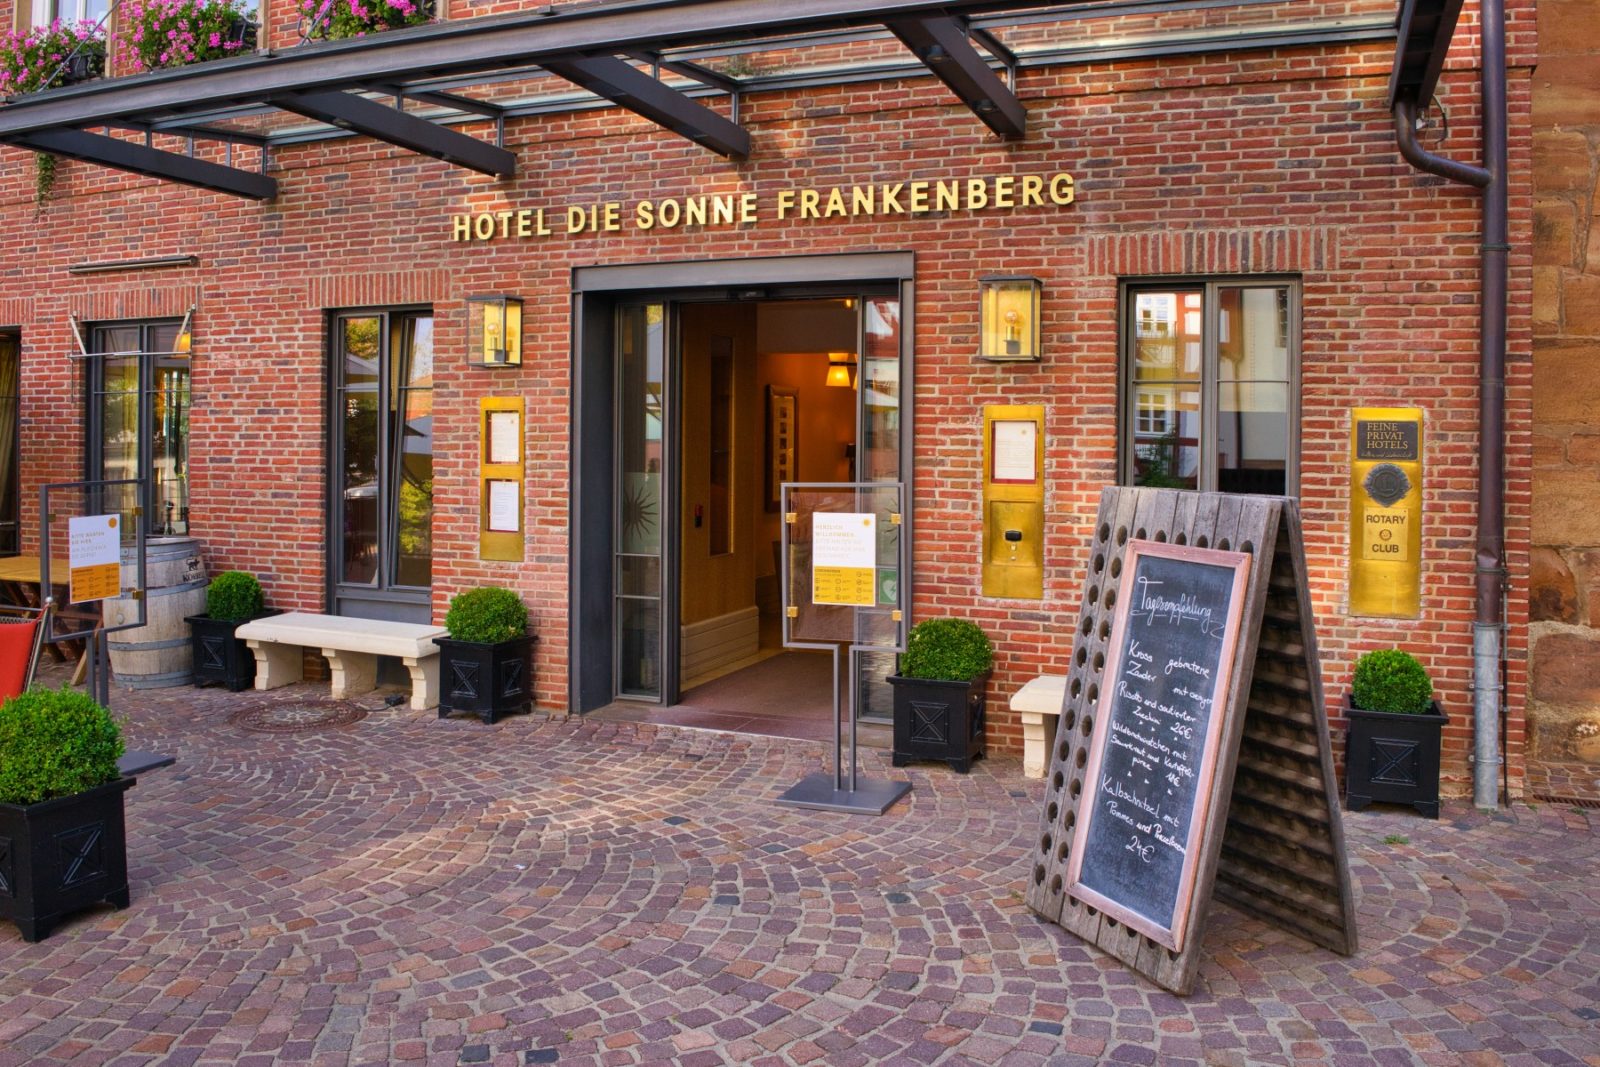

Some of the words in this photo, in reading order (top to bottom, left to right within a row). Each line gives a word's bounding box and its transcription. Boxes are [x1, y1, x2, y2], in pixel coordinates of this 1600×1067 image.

[453, 208, 551, 242] HOTEL
[567, 203, 620, 234] DIE
[636, 193, 758, 230] SONNE
[777, 172, 1076, 220] FRANKENBERG
[1367, 422, 1398, 431] FEINE
[1367, 431, 1404, 440] PRIVAT
[1366, 440, 1409, 449] HOTELS
[1366, 514, 1406, 524] ROTARY
[1371, 543, 1399, 553] CLUB
[1172, 686, 1189, 696] mit
[1144, 699, 1158, 709] und
[1170, 722, 1193, 740] 26€
[1172, 751, 1188, 761] mit
[1106, 800, 1134, 826] Pommes
[1136, 822, 1152, 834] und
[1163, 814, 1180, 827] mit
[1125, 835, 1155, 863] 24€
